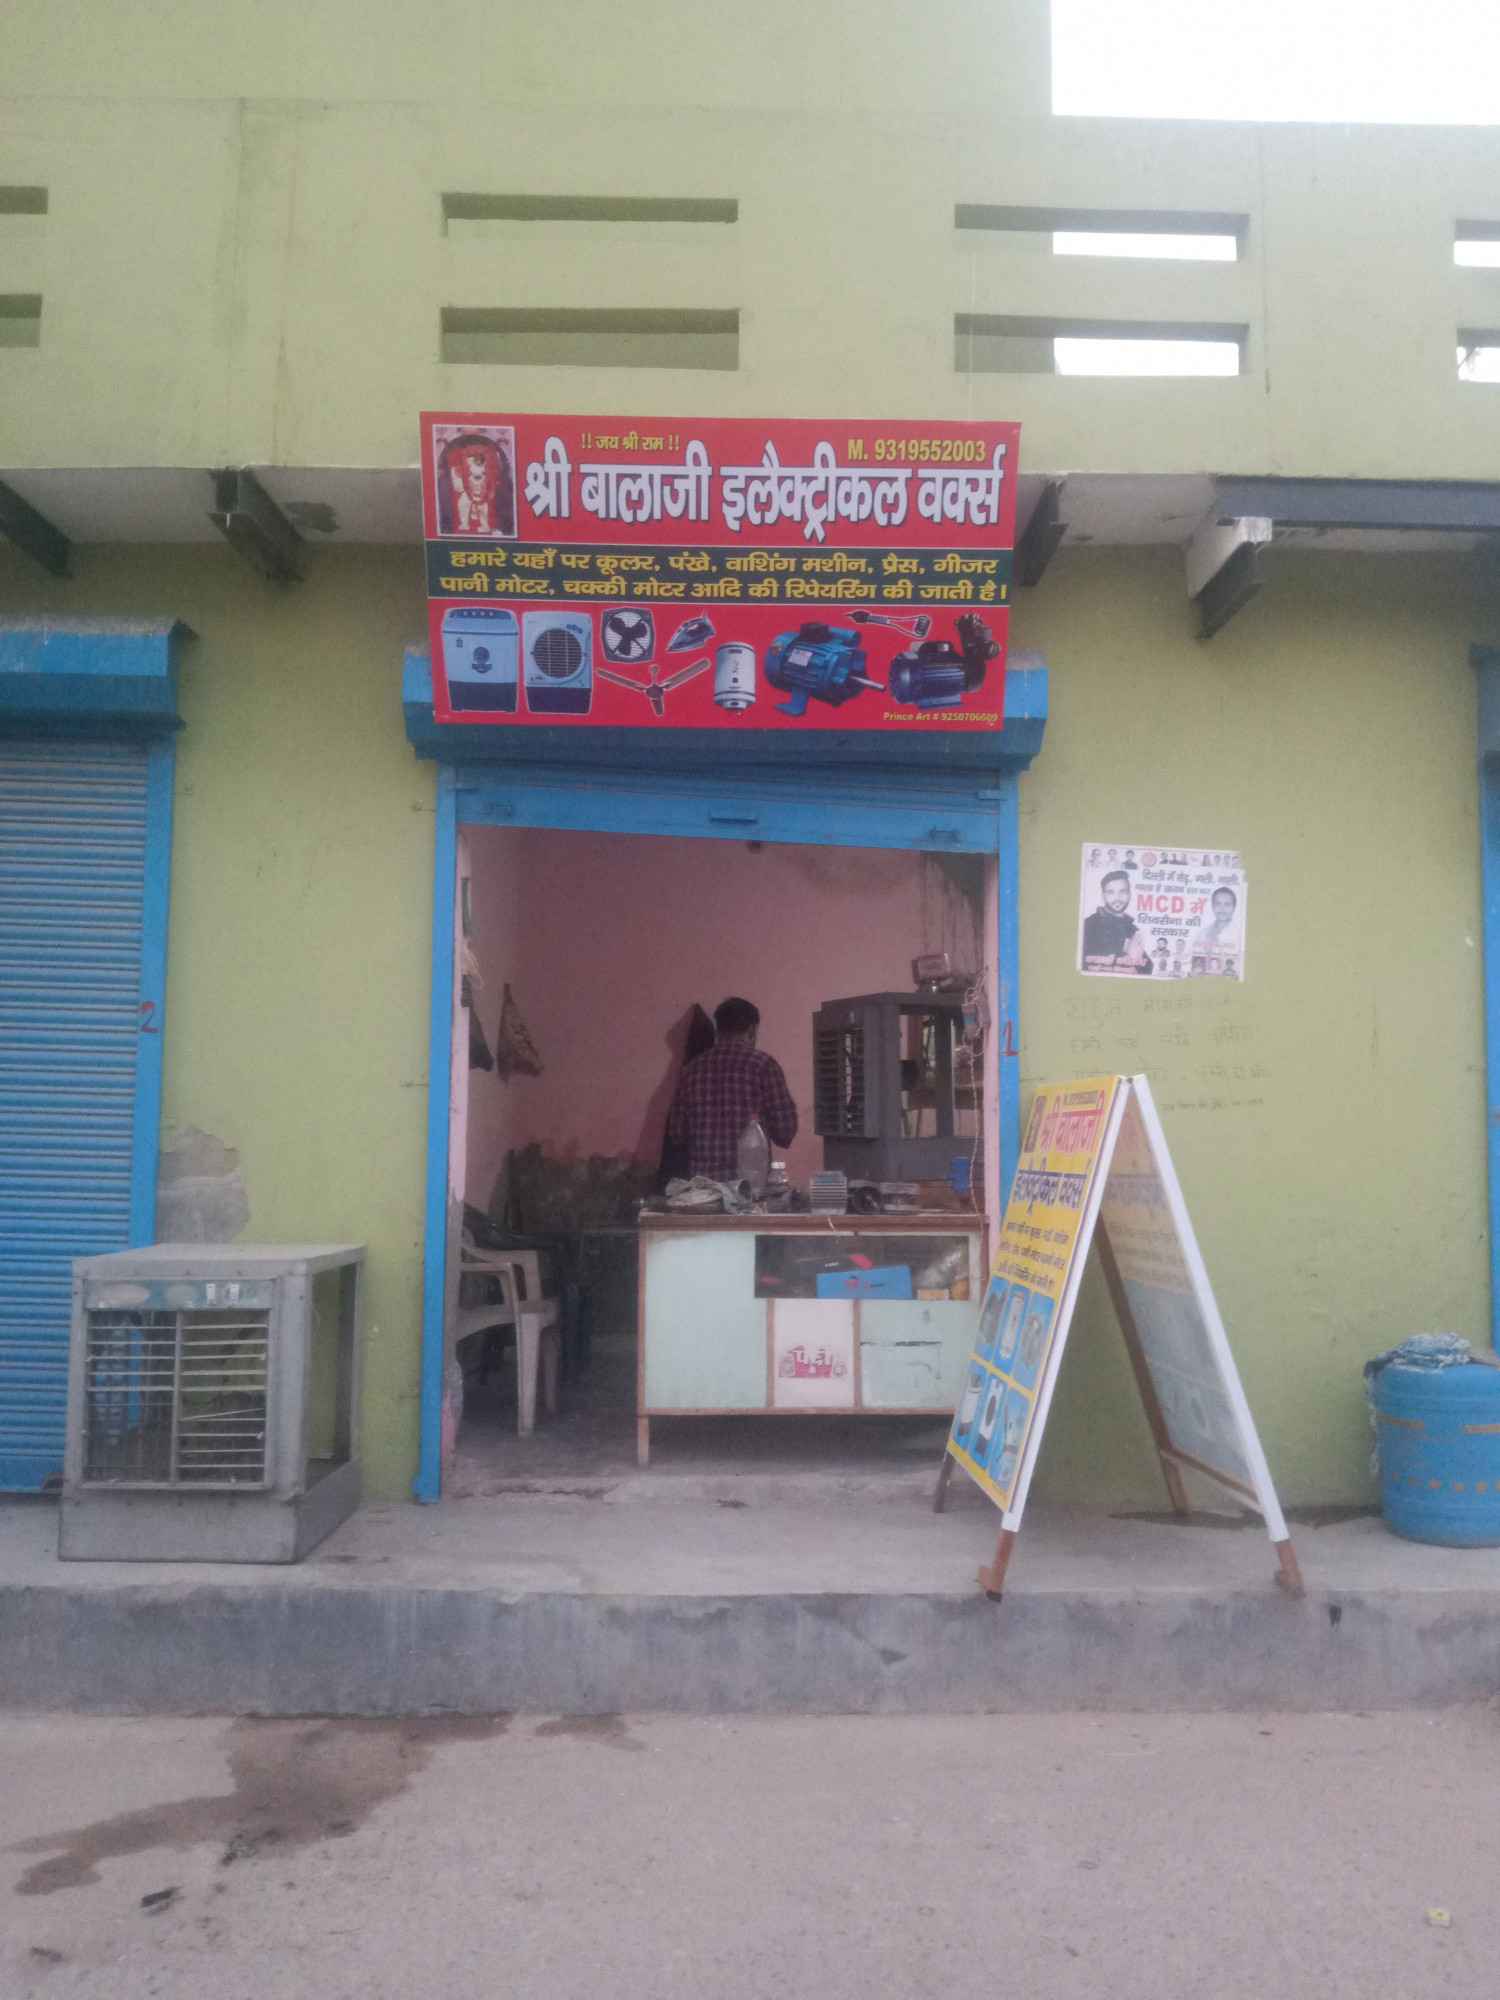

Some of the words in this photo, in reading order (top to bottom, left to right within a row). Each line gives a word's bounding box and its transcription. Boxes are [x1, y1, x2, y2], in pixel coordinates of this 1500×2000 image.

[595, 435, 619, 450] जय
[622, 431, 639, 450] श्री
[641, 436, 664, 450] राम
[848, 439, 868, 460] M.
[875, 440, 986, 462] 9319552003
[524, 436, 572, 518] श्री
[580, 440, 712, 523] बालाजी
[917, 444, 1006, 525] वर्क्स
[450, 548, 507, 568] हमारे
[513, 548, 557, 570] यहाँ
[561, 554, 592, 570] पर
[596, 555, 660, 575] कूलर,
[668, 551, 717, 573] पंखे,
[725, 551, 797, 572] वाशिंग
[802, 552, 874, 574] मशीन,
[933, 553, 999, 574] गीजर
[440, 572, 489, 593] पानी
[496, 574, 555, 596] मोटर,
[563, 575, 627, 596] चक्की
[633, 576, 684, 597] मोटर
[690, 577, 742, 598] आदि
[748, 578, 778, 599] की
[785, 578, 876, 600] रिपेयरिंग
[882, 579, 914, 599] की
[918, 579, 974, 600] जाती
[883, 711, 913, 721] Prince
[916, 712, 930, 721] Art
[1136, 894, 1185, 914] MCD
